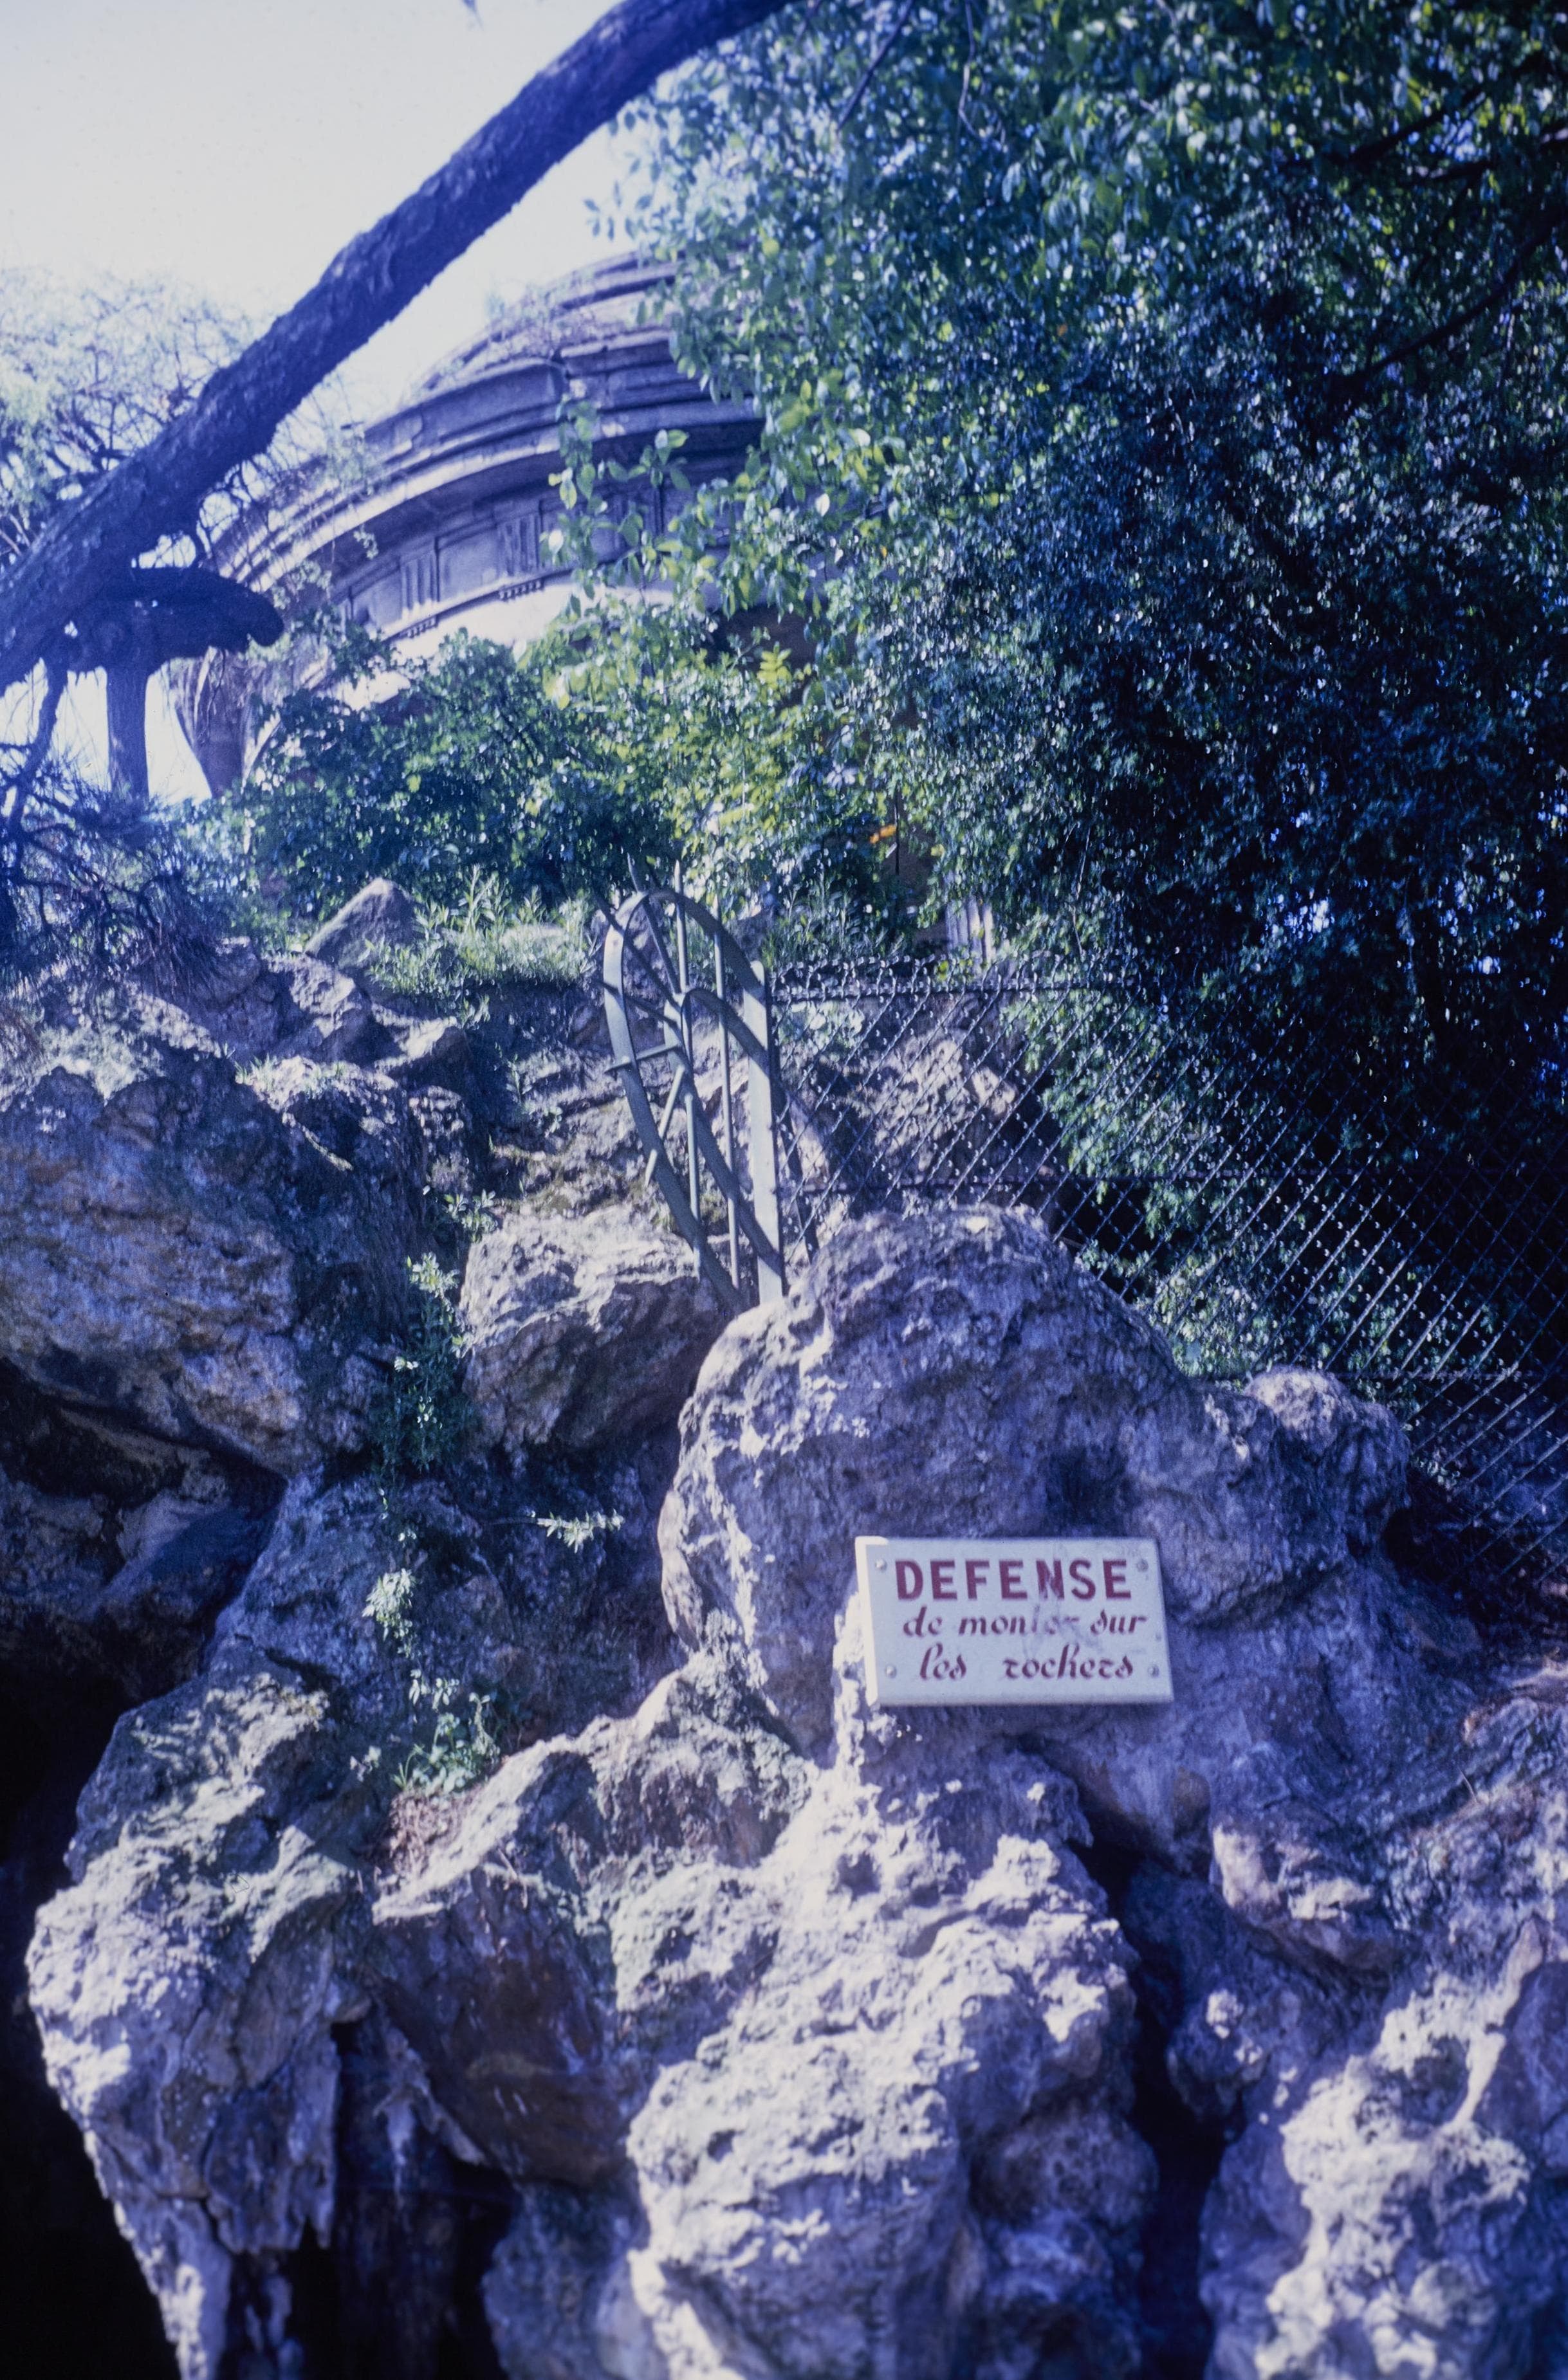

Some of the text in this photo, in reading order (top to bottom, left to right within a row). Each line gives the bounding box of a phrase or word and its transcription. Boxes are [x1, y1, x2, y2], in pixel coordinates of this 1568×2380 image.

[895, 1559, 1132, 1600] DEFENSE
[903, 1606, 943, 1636] de
[1091, 1609, 1148, 1634] sur
[919, 1642, 1134, 1681] les rochers
